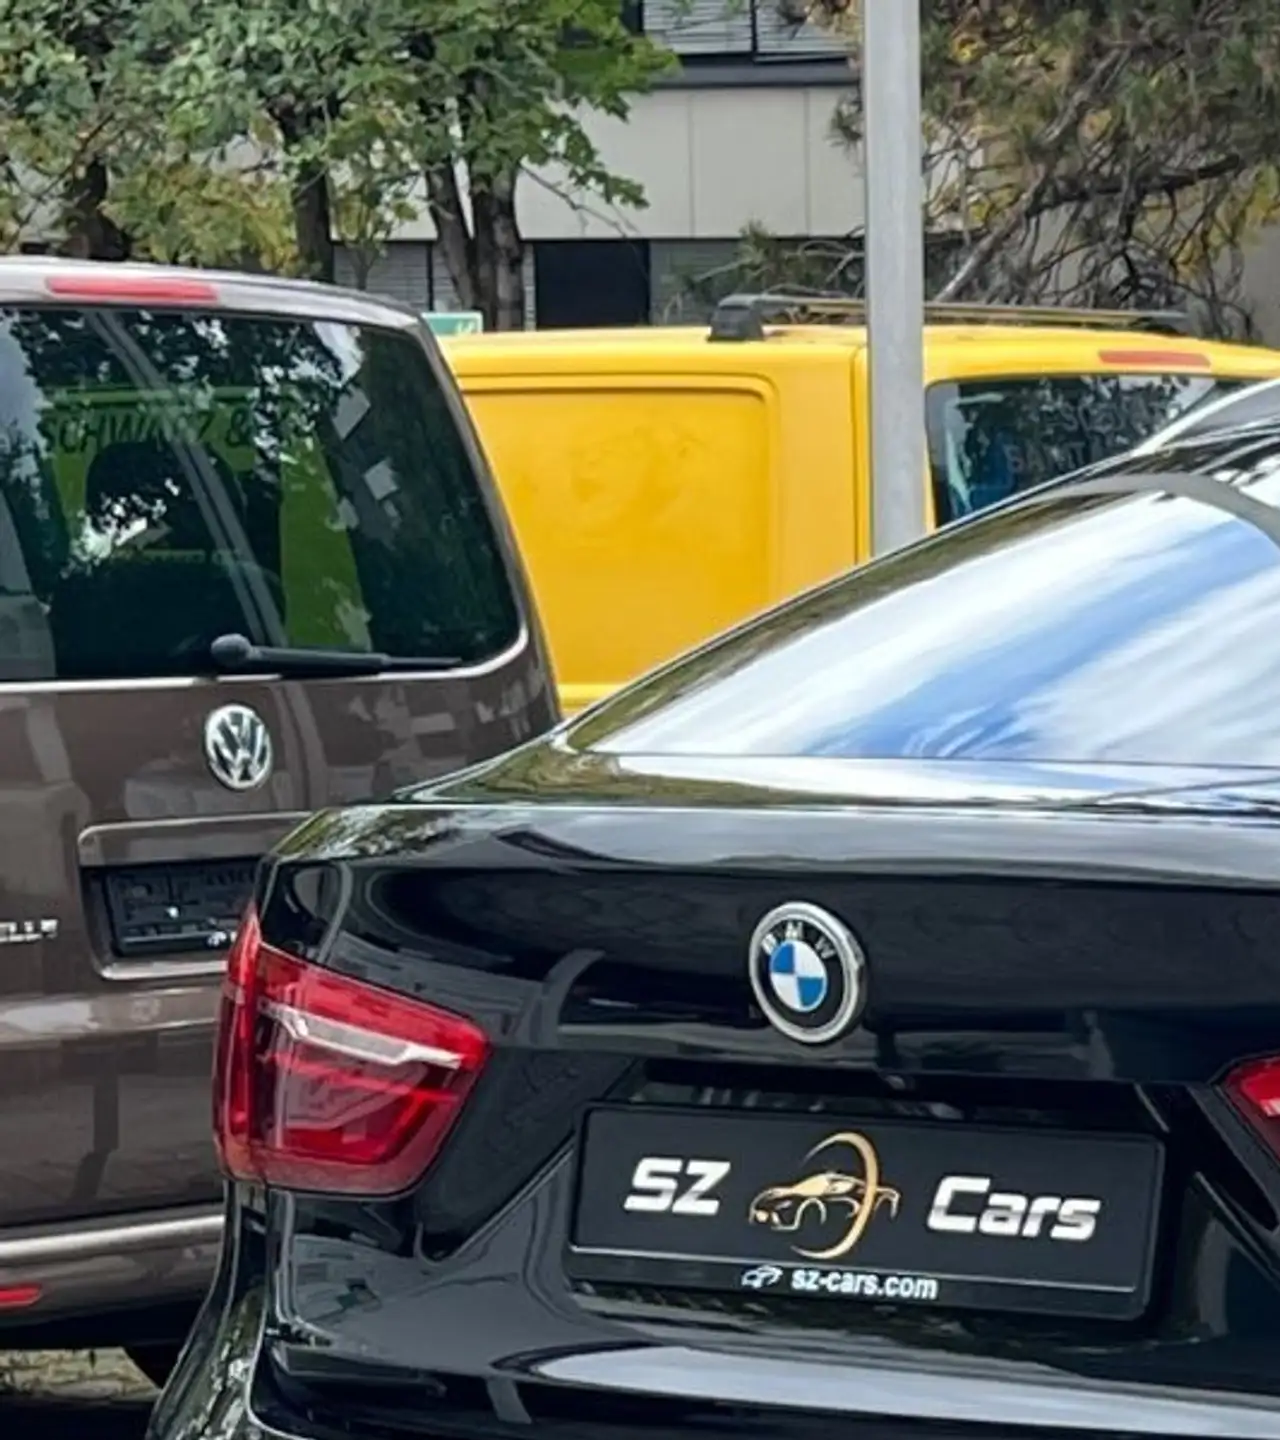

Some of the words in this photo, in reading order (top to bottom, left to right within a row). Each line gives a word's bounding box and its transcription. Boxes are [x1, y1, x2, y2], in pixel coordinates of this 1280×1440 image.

[760, 919, 838, 960] BMW
[623, 1156, 731, 1216] SZ
[926, 1175, 1101, 1241] Cars
[791, 1267, 938, 1300] sz-cars.com
